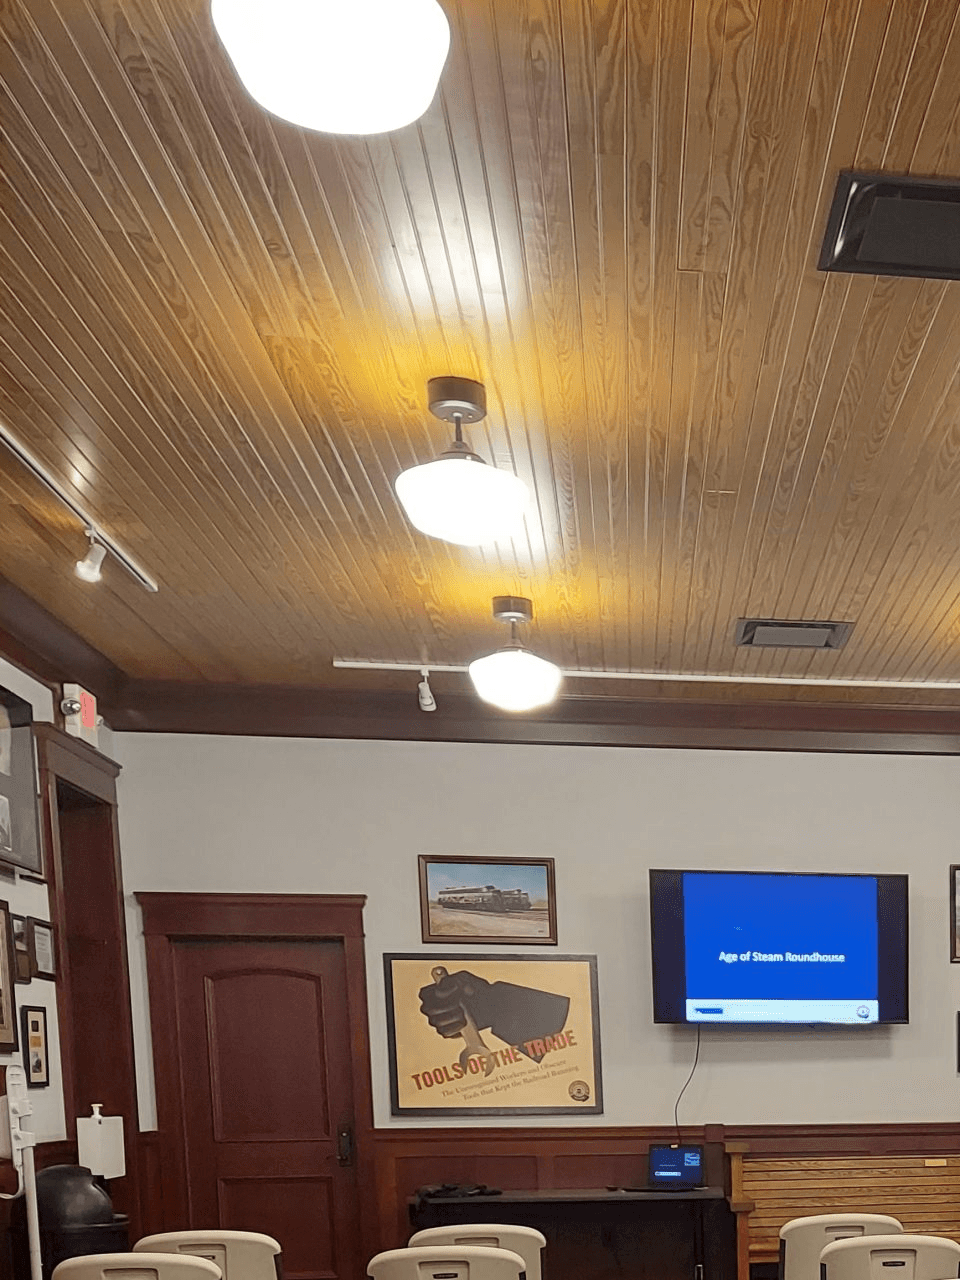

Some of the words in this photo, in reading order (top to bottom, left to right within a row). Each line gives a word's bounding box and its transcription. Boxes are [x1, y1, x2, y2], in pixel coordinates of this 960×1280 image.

[719, 951, 738, 963] Age
[739, 951, 751, 962] of
[752, 951, 784, 962] Steam
[785, 951, 846, 962] Roundhouse
[411, 1062, 464, 1090] TOOLS
[468, 1055, 487, 1075] OF
[490, 1045, 523, 1067] THE
[524, 1030, 578, 1058] TRADE
